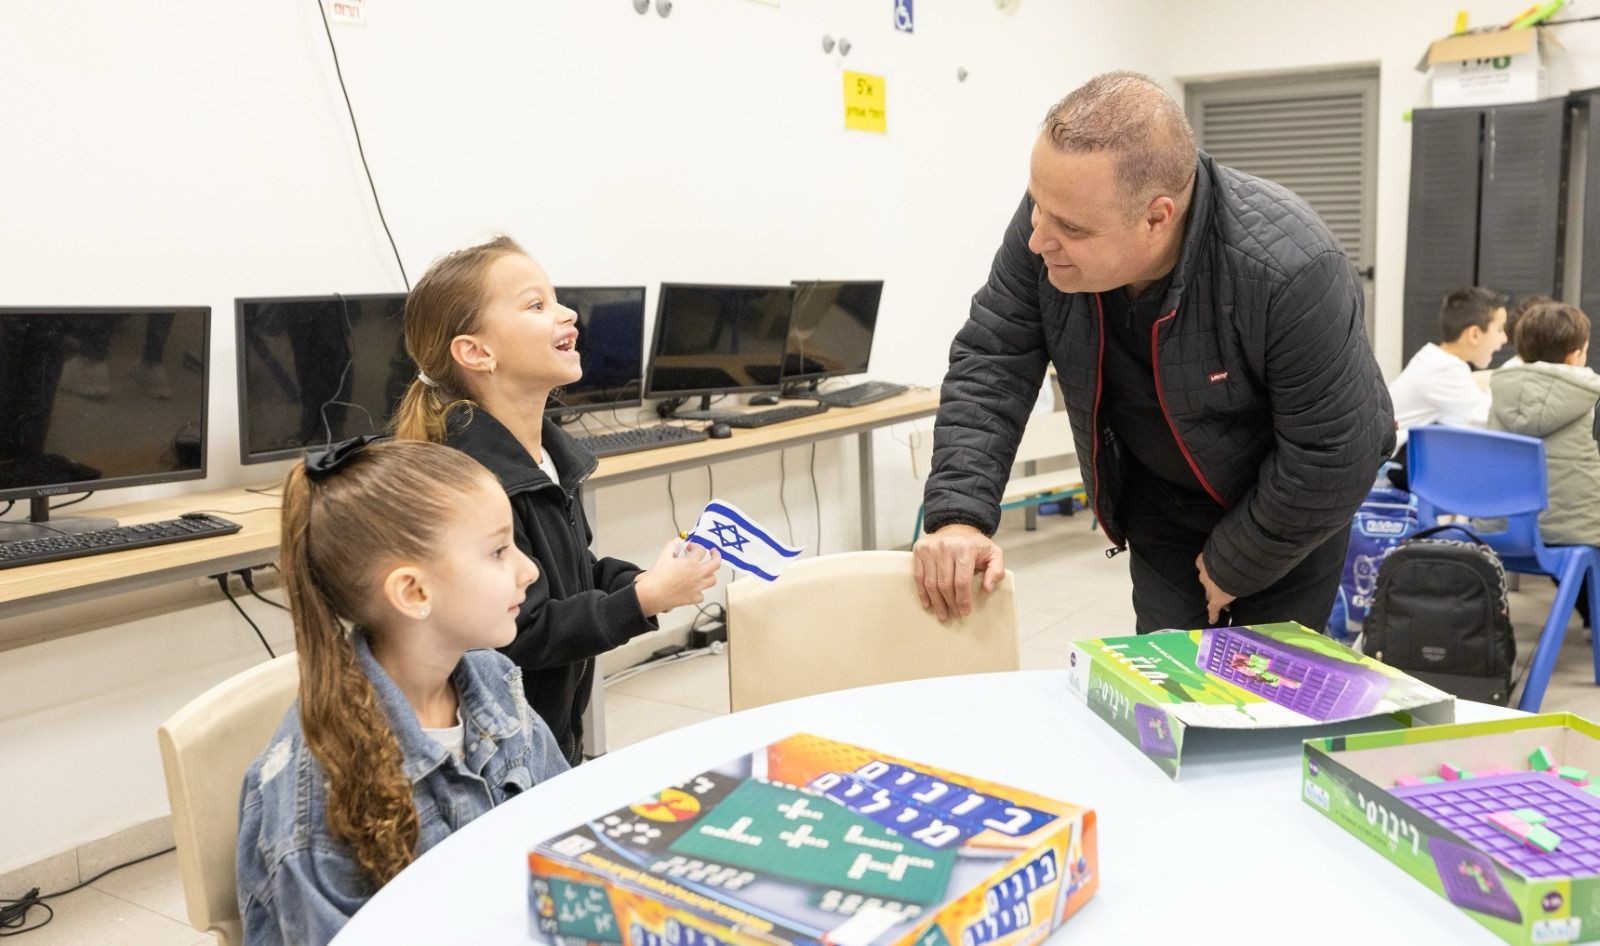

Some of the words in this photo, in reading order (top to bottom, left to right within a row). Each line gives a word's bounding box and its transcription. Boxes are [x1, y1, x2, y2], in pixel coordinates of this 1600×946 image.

[810, 772, 961, 848] מילים
[854, 760, 1033, 837] בונים
[1357, 791, 1421, 856] ריברסי
[985, 853, 1057, 914] בונים
[961, 900, 1030, 946] מילים
